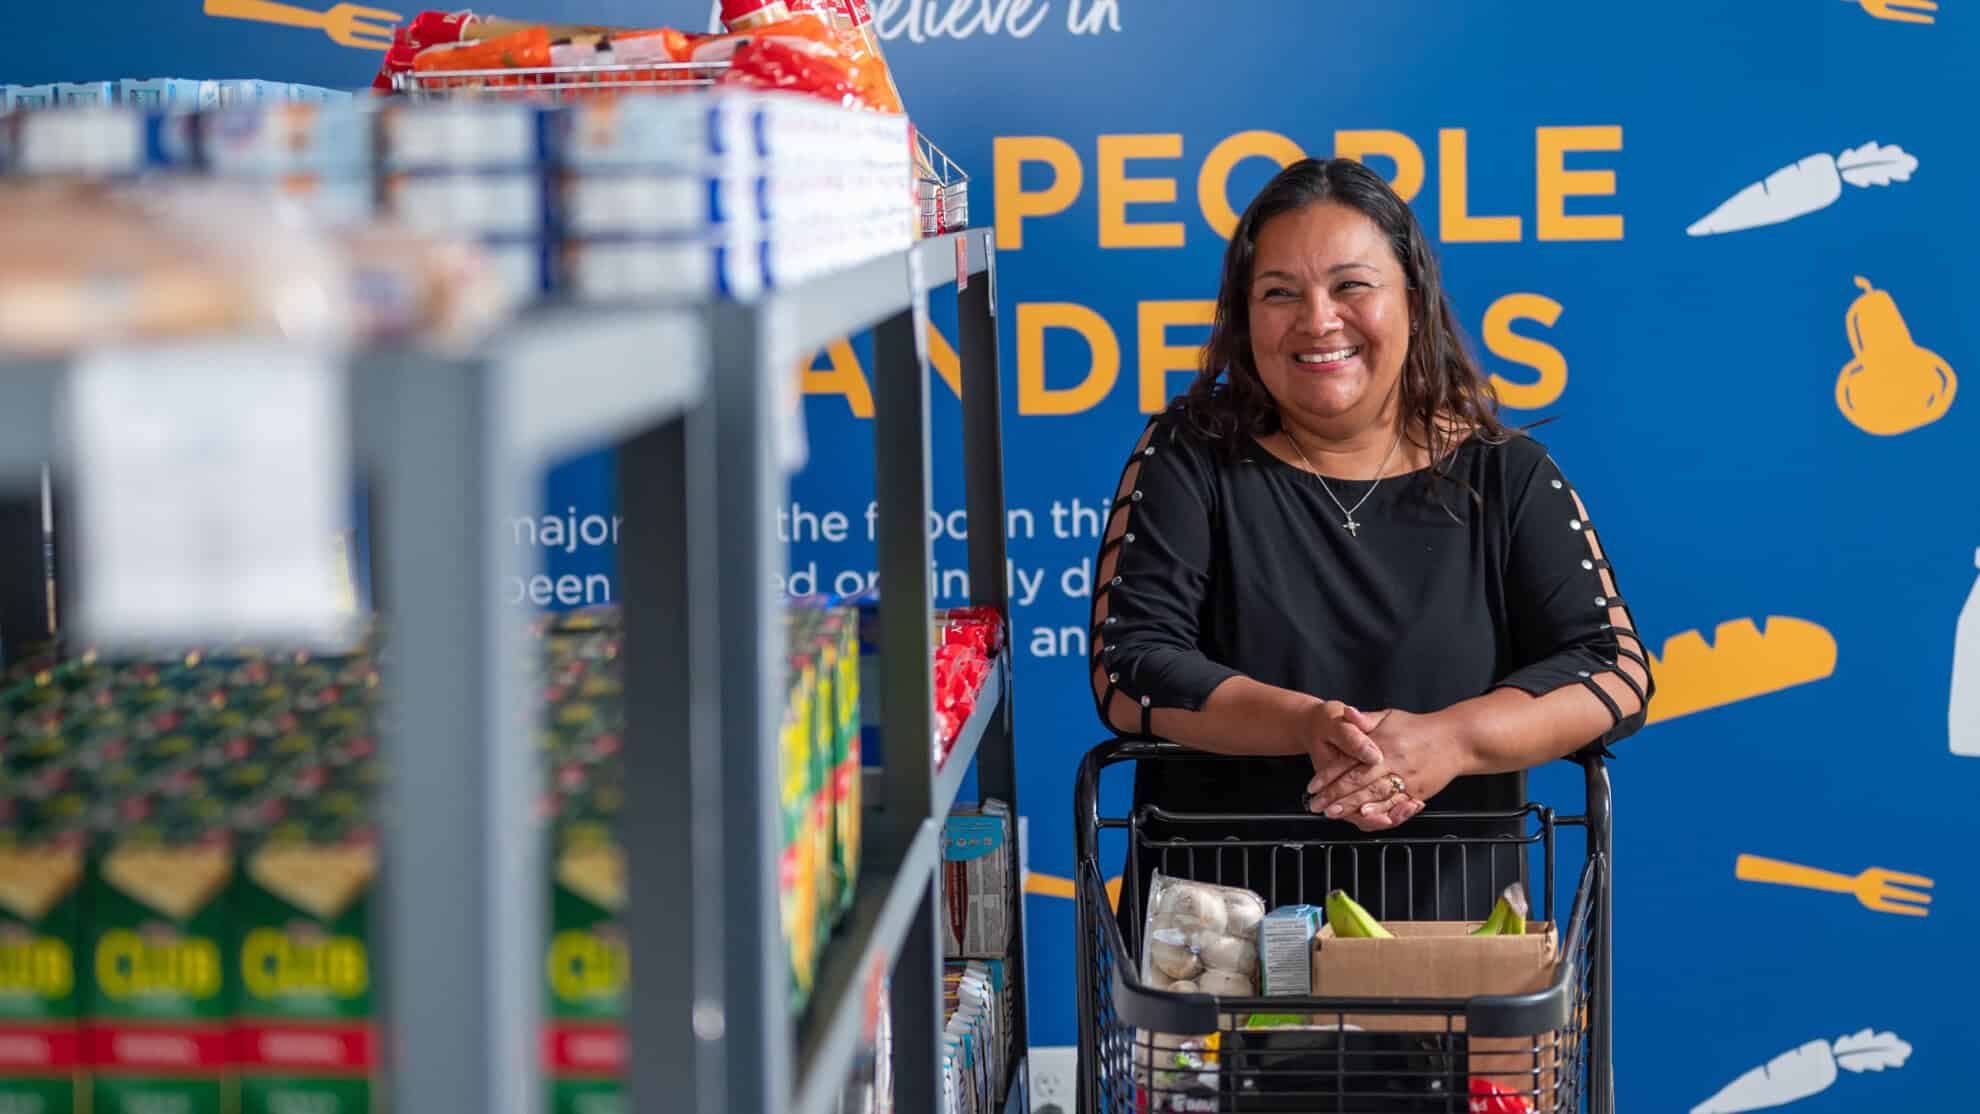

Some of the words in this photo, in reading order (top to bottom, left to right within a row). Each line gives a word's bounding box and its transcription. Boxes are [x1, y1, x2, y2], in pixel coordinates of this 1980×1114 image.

[876, 0, 1049, 43] elieve
[994, 125, 1624, 250] PEOPLE
[775, 502, 849, 542] the
[1051, 499, 1111, 539] thi
[511, 573, 611, 605] een
